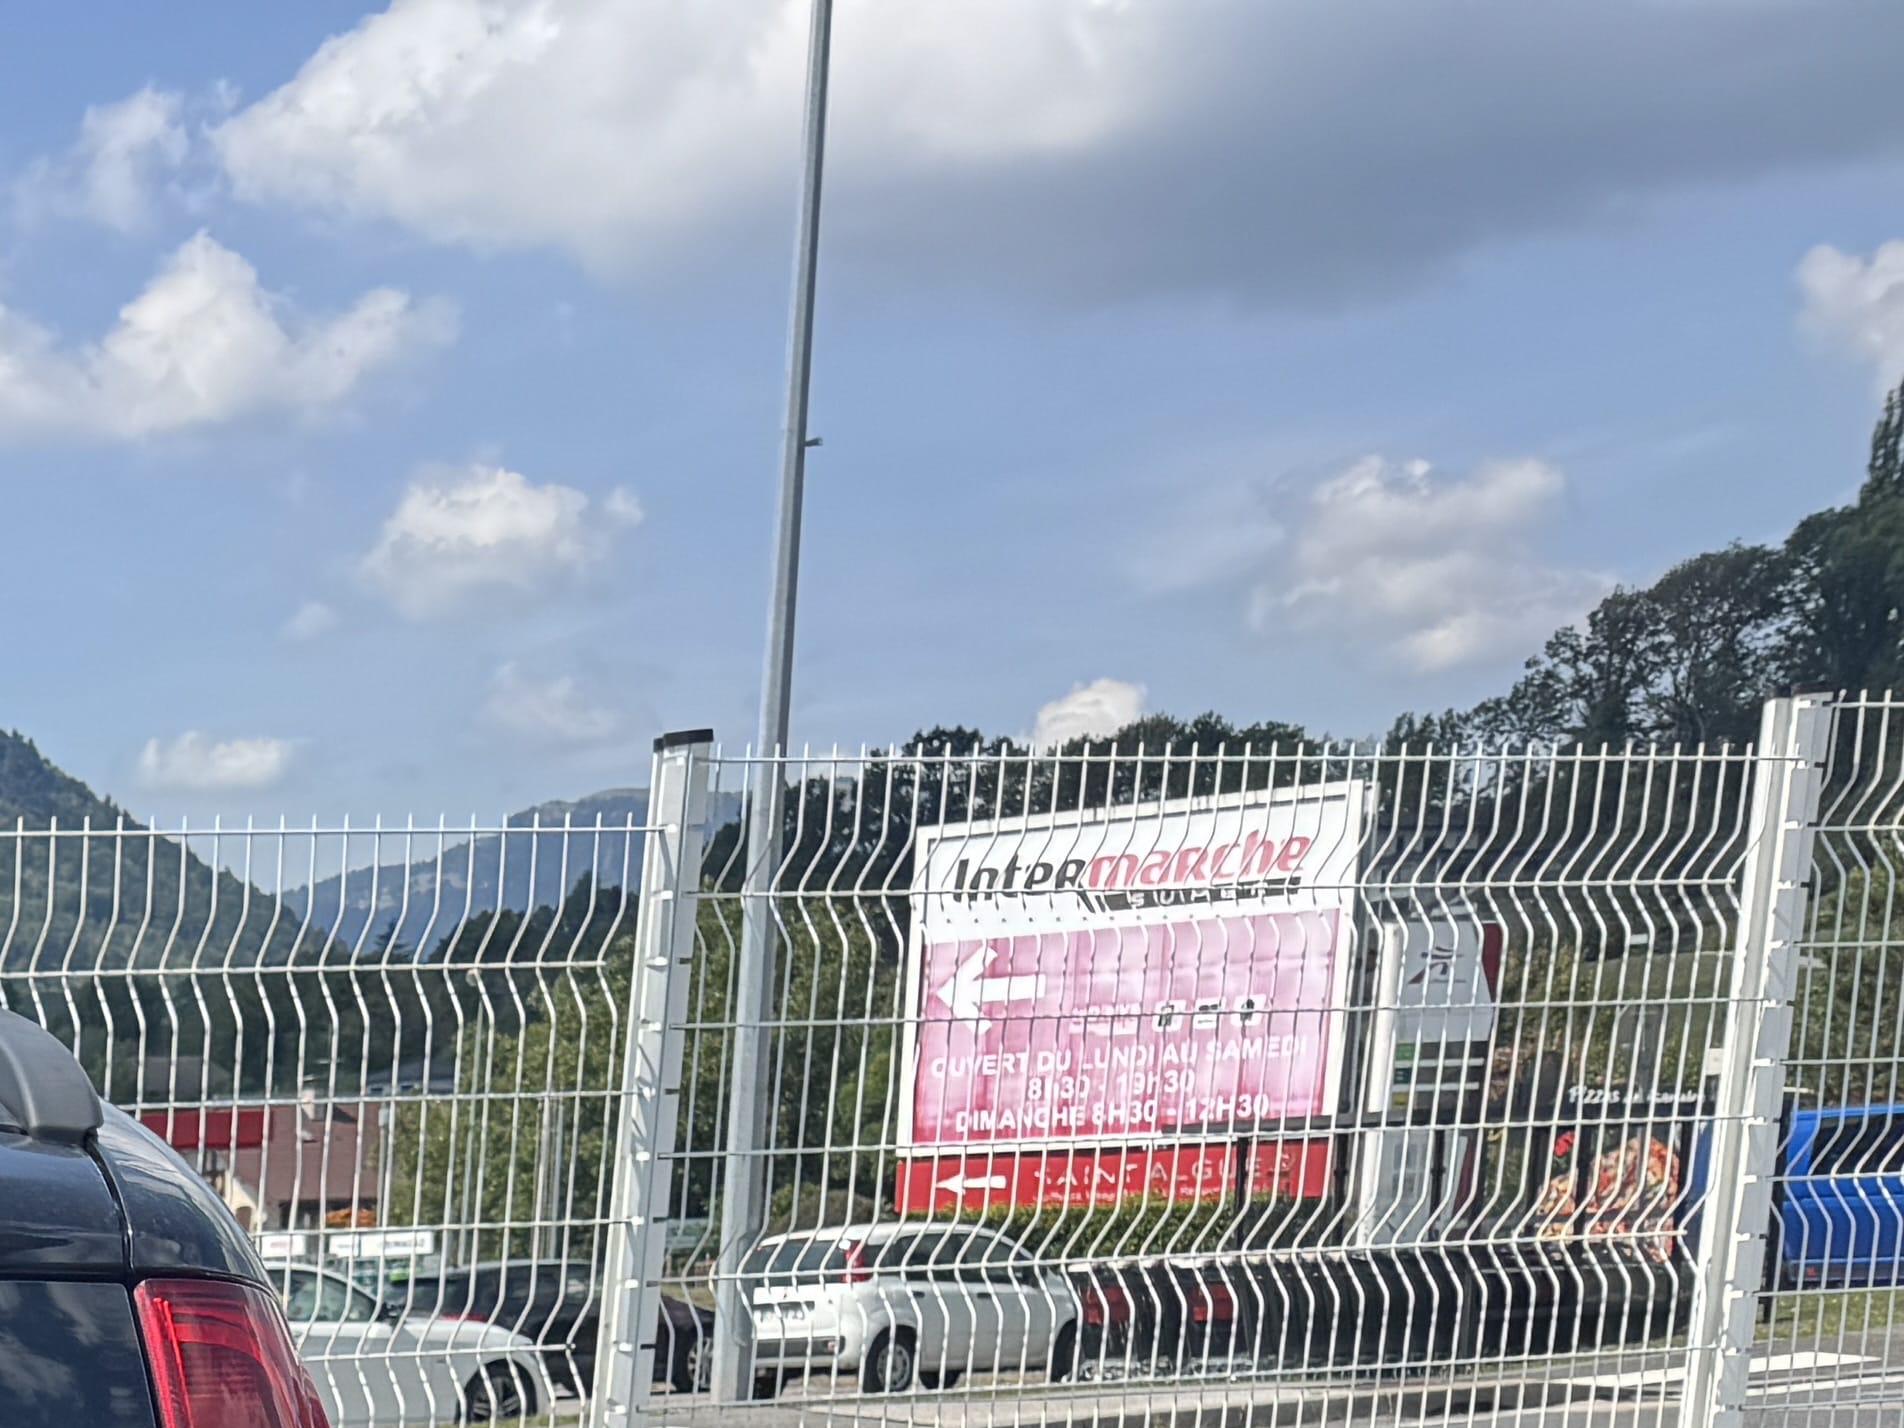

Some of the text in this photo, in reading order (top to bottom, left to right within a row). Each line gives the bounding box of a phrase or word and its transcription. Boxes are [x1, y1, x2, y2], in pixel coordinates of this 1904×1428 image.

[931, 1052, 1029, 1078] OUVERT
[1037, 1049, 1072, 1074] DU
[1163, 1039, 1198, 1065] AU
[1205, 1034, 1307, 1062] SAMEDI
[1116, 1069, 1196, 1096] 19h30
[955, 1104, 1087, 1133] DIMANCHE
[1185, 1094, 1270, 1121] 12H30
